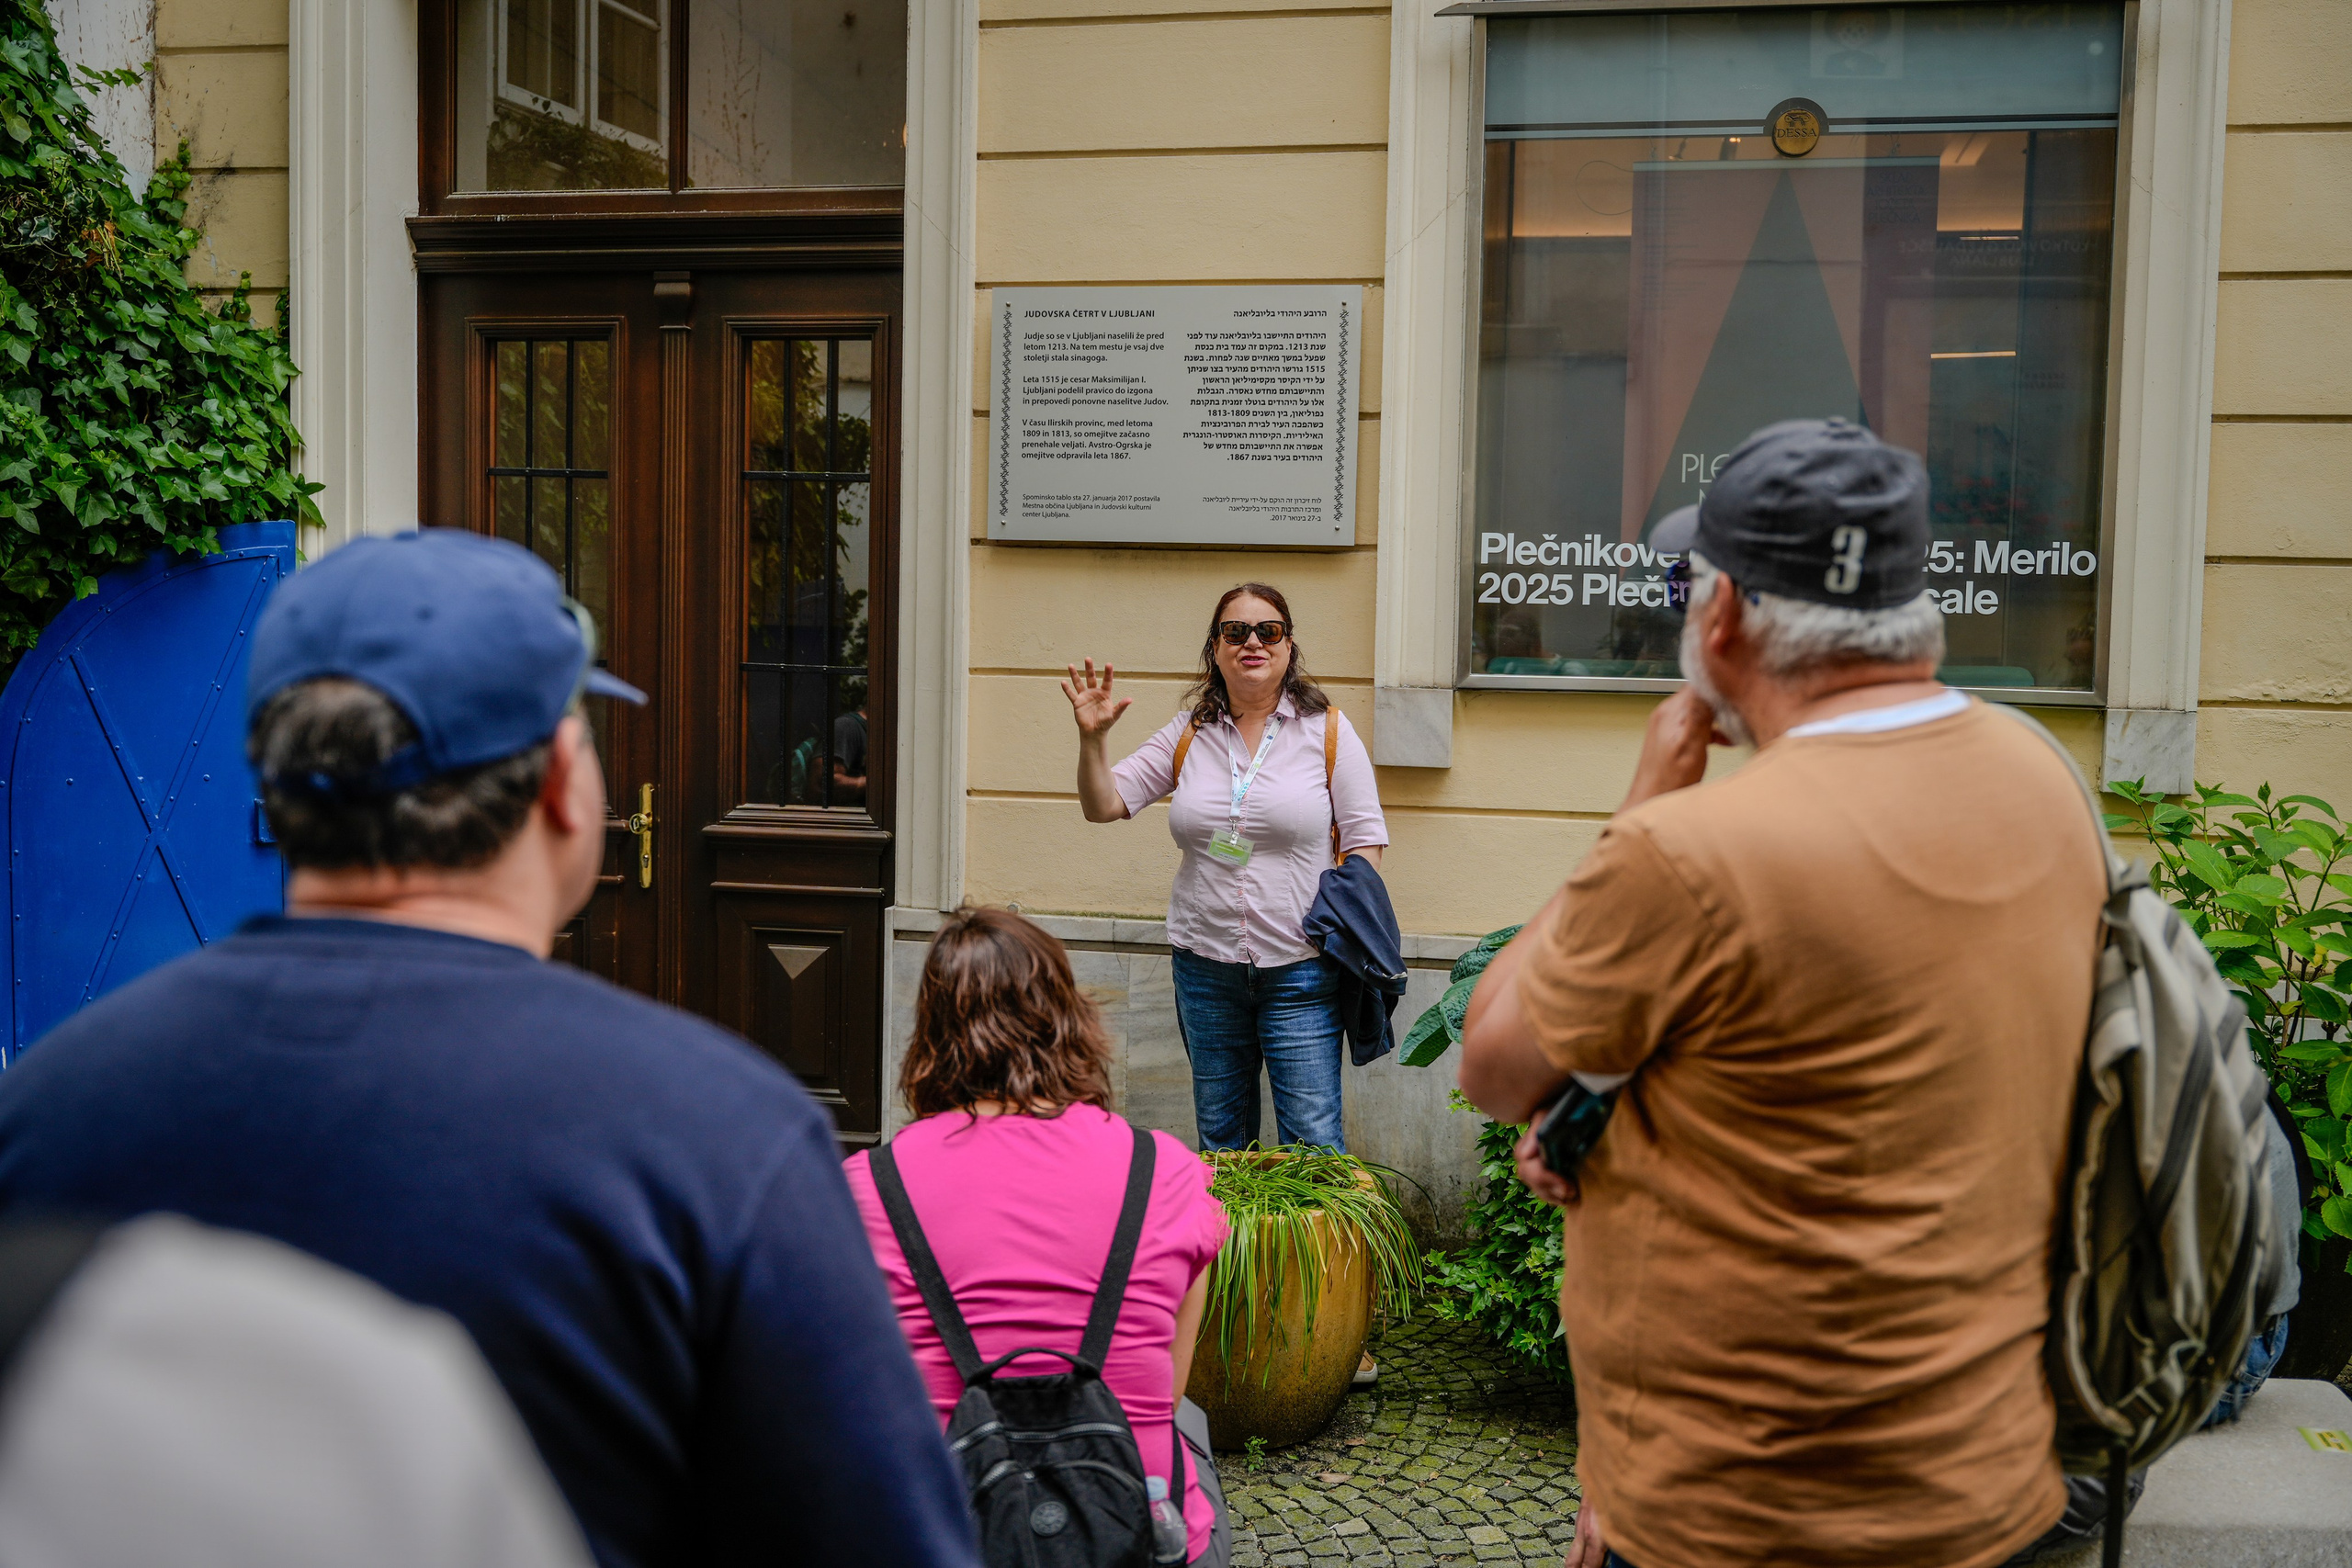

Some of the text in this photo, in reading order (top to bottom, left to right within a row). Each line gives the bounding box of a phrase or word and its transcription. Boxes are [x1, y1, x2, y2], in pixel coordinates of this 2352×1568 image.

[1776, 128, 1817, 139] DESSA
[1023, 310, 1070, 318] JUDOVSKA
[1072, 309, 1099, 318] ČETRT
[1233, 309, 1275, 317] בליובליאנה
[1023, 332, 1045, 341] Judje
[1072, 332, 1105, 341] Ljubljani
[1107, 332, 1134, 340] naselili
[1146, 332, 1164, 341] pred
[1186, 331, 1203, 339] לפני
[1219, 331, 1261, 339] בליובליאנה
[1081, 343, 1097, 351] tem
[1124, 343, 1132, 352] je
[1133, 343, 1148, 352] vsaj
[1149, 342, 1164, 350] dve
[1258, 344, 1283, 352] במקום
[1023, 353, 1107, 363] stoletji stala sinagoga.
[1281, 355, 1303, 363] במשך
[1304, 353, 1326, 362] שפעל
[1187, 366, 1208, 374] שניתן
[1305, 365, 1326, 373] 1515
[1023, 375, 1039, 383] Leta
[1041, 375, 1059, 383] 1515
[1060, 375, 1069, 385] je
[1091, 375, 1139, 385] Maksimilijan
[1202, 377, 1230, 385] הראשון
[1231, 375, 1275, 385] מקסימיליאן
[1277, 377, 1301, 386] הקיסר
[1314, 375, 1325, 384] על
[1023, 386, 1153, 396] Ljubljani podelil pravico do izgona
[1196, 386, 1224, 394] הגבלות
[1031, 397, 1070, 406] prepovedi
[1107, 397, 1142, 405] naselitve
[1143, 397, 1169, 405] Judov.
[1190, 399, 1220, 407] בתקופת
[1244, 397, 1266, 405] בוטלו
[1298, 397, 1309, 406] על
[1310, 398, 1324, 406] אלו
[1276, 410, 1288, 418] בין
[1022, 418, 1152, 428] V času Ilirskih provinc, med letoma
[1248, 419, 1270, 427] לבירת
[1022, 429, 1041, 437] 1809
[1042, 429, 1049, 437] in
[1051, 429, 1072, 438] 1813,
[1083, 430, 1117, 439] omejitve
[1118, 430, 1150, 438] začasno
[1249, 432, 1281, 440] הקיסרות
[1021, 440, 1151, 450] prenehale veljati. Avstro-Ogrska je
[1203, 441, 1214, 449] של
[1021, 450, 1131, 460] omejitve odpravila leta 1867.
[1092, 494, 1117, 503] januarja
[1117, 494, 1133, 502] 2017
[1066, 502, 1093, 511] Ljubljana
[1480, 532, 1681, 568] Plečnikove
[1974, 540, 2097, 576] Merilo
[1824, 525, 1868, 594] 3
[1477, 572, 1574, 605] 2025
